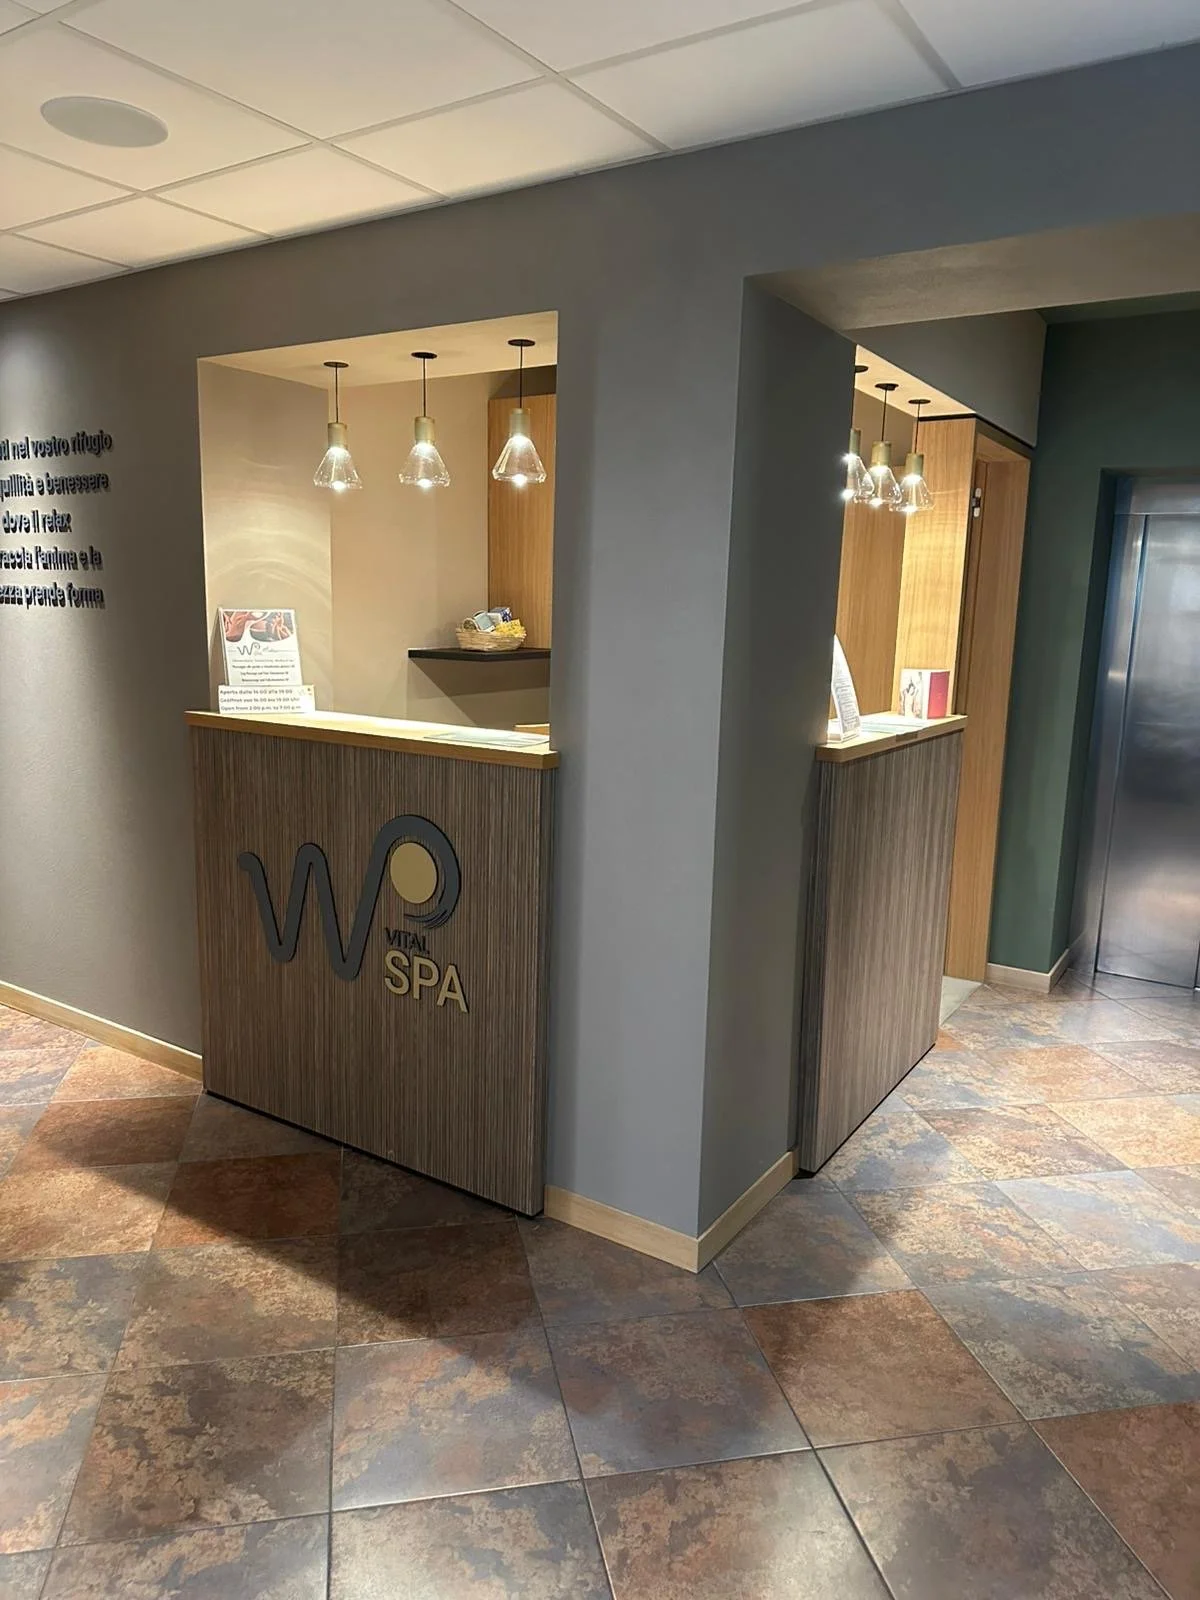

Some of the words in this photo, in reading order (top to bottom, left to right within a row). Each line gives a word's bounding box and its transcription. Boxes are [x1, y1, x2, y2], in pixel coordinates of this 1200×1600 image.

[11, 436, 30, 459] nel
[31, 436, 70, 458] vostro
[70, 430, 113, 457] rifugio
[36, 477, 45, 496] e
[45, 472, 110, 496] benessere
[3, 510, 30, 533] dove
[41, 509, 72, 533] relax
[34, 545, 78, 570] l'anima
[79, 550, 89, 570] e
[89, 545, 103, 570] la
[24, 582, 66, 609] prende
[67, 582, 105, 608] forma
[384, 927, 430, 954] VITAL
[384, 950, 469, 1013] SPA
